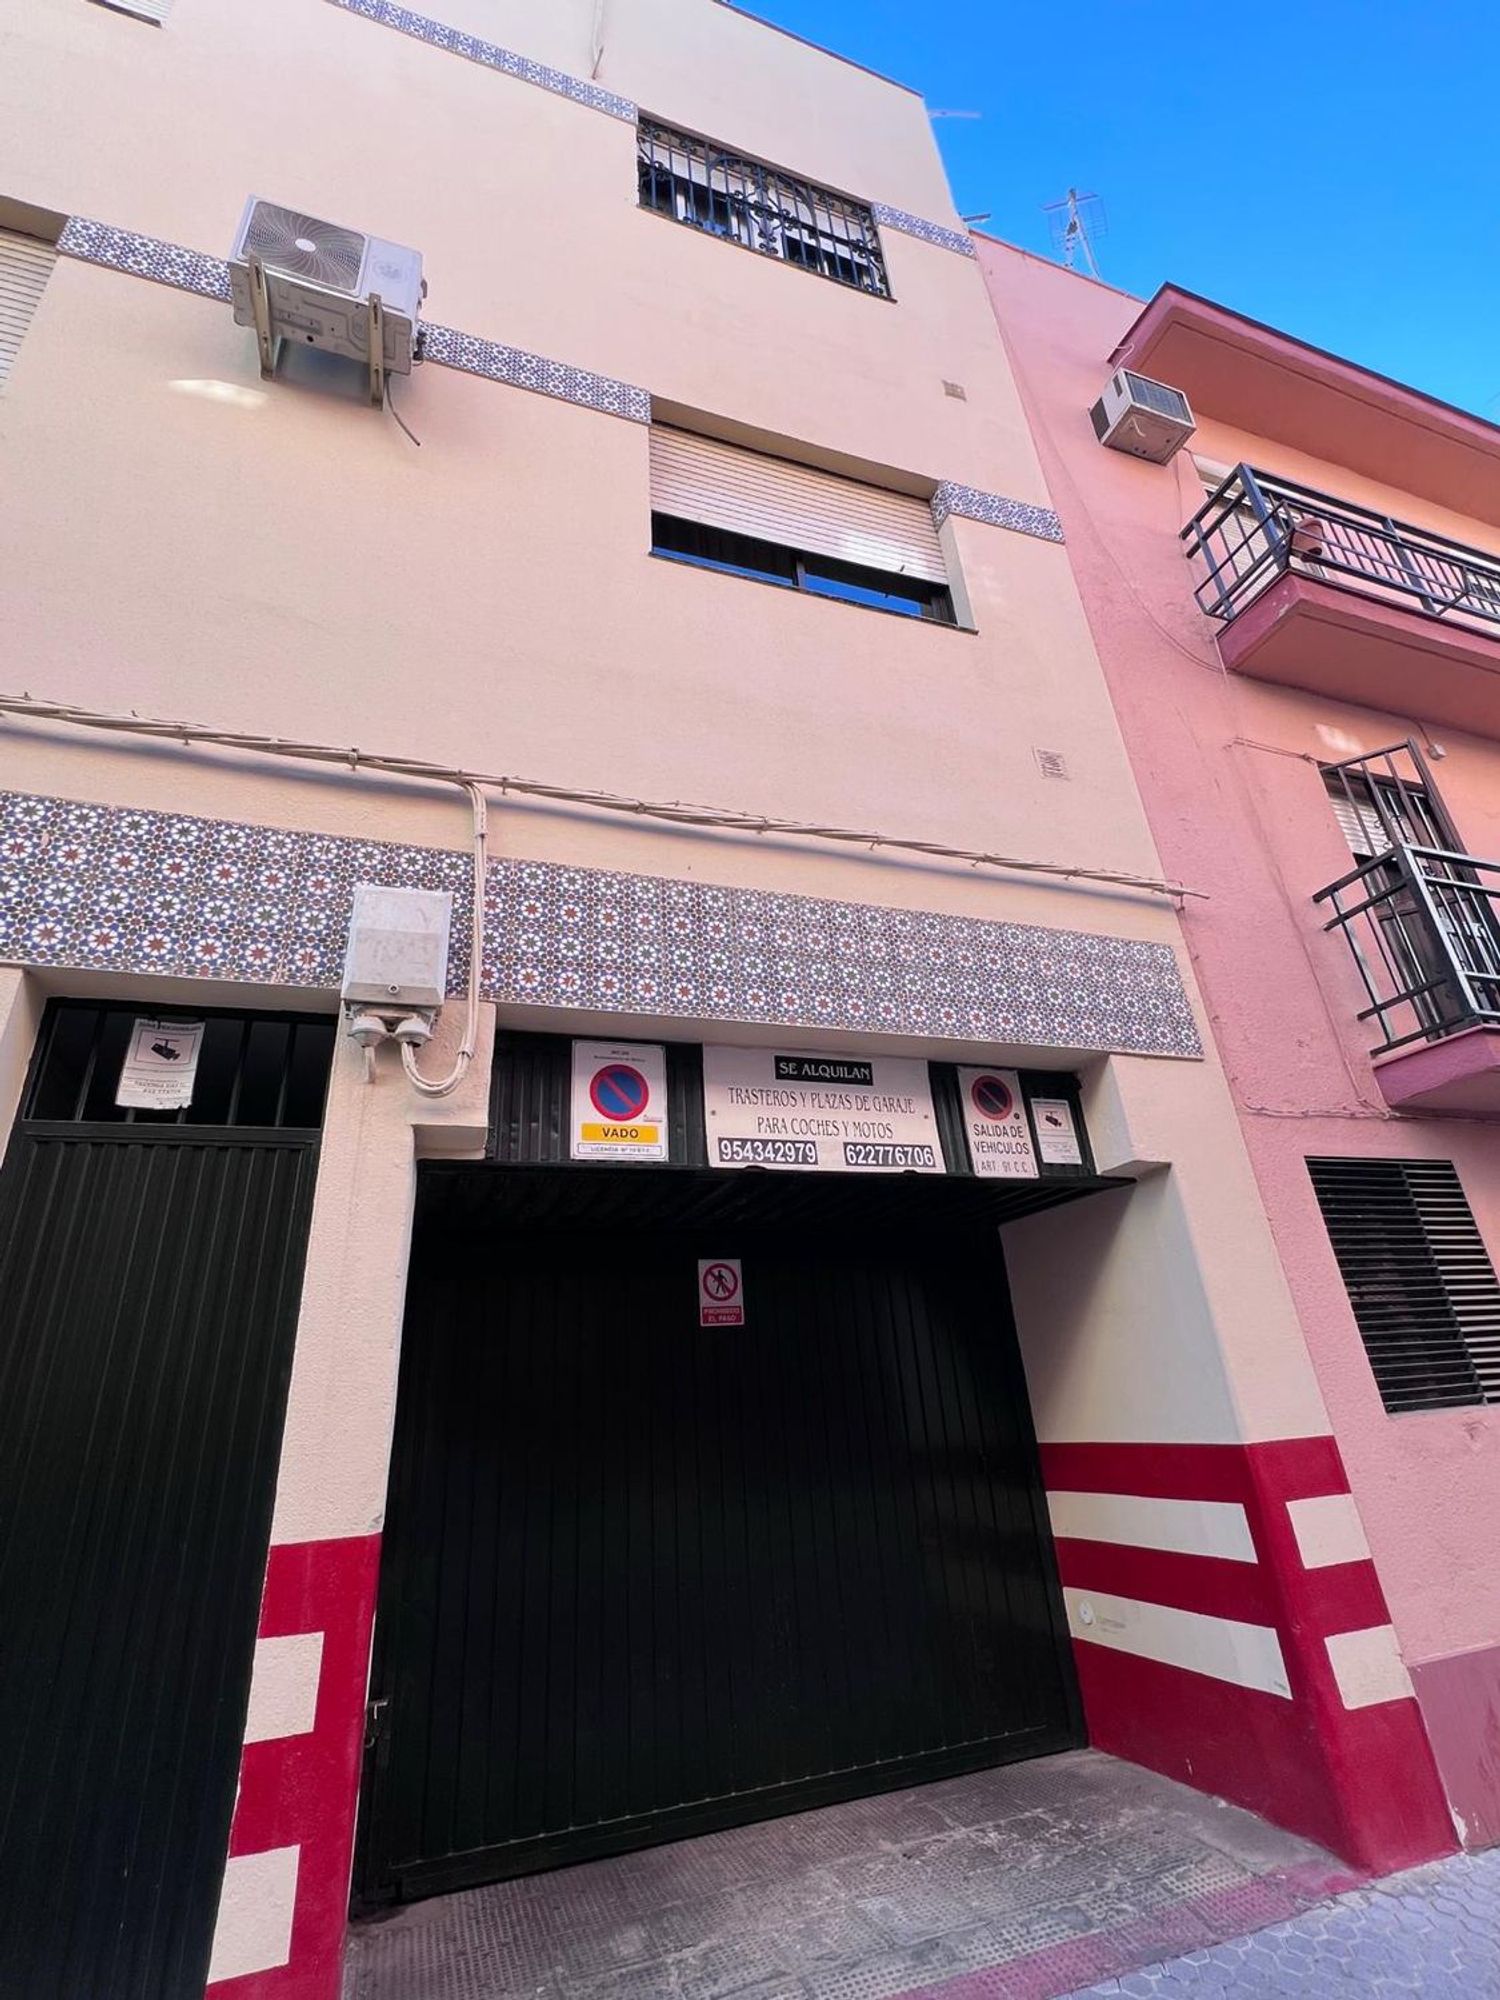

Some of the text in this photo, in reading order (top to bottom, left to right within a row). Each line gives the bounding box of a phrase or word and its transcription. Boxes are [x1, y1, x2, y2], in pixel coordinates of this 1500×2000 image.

[779, 1062, 871, 1080] SE ALQUILAN
[727, 1087, 916, 1114] TRASTEROS Y PLAZAS DE GARAJE
[602, 1127, 639, 1139] VADO
[757, 1116, 894, 1139] PARA COCHES Y MOTOS
[973, 1123, 1025, 1138] SALIDA DE
[720, 1140, 816, 1163] 954342979
[846, 1145, 934, 1166] 622776706
[973, 1141, 1030, 1155] VEHICULOS
